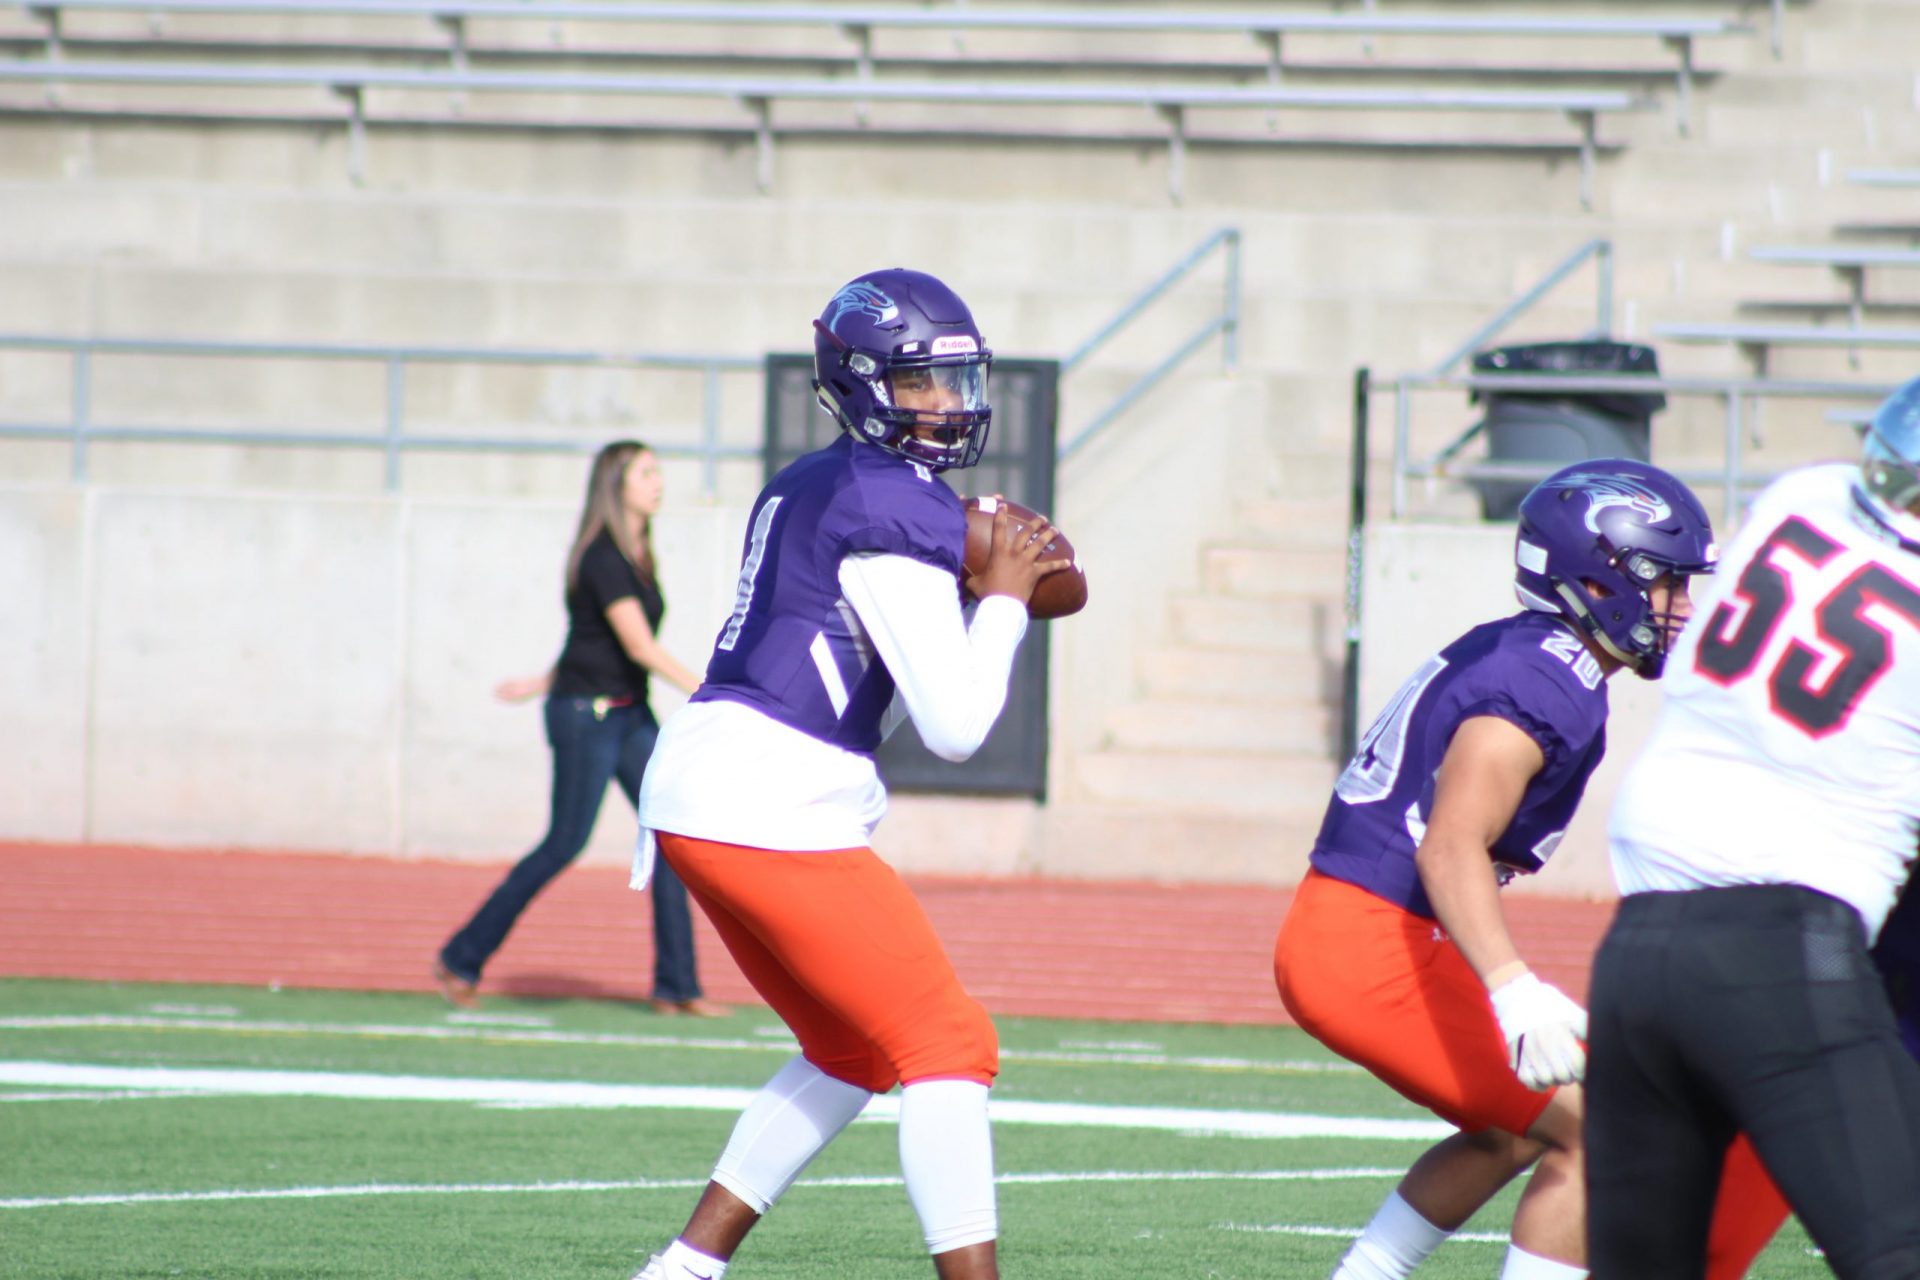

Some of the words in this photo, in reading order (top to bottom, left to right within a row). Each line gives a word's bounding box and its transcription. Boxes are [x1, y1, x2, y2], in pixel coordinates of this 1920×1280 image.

[717, 495, 784, 651] 1
[1691, 513, 1920, 741] 55
[1540, 629, 1604, 690] 20
